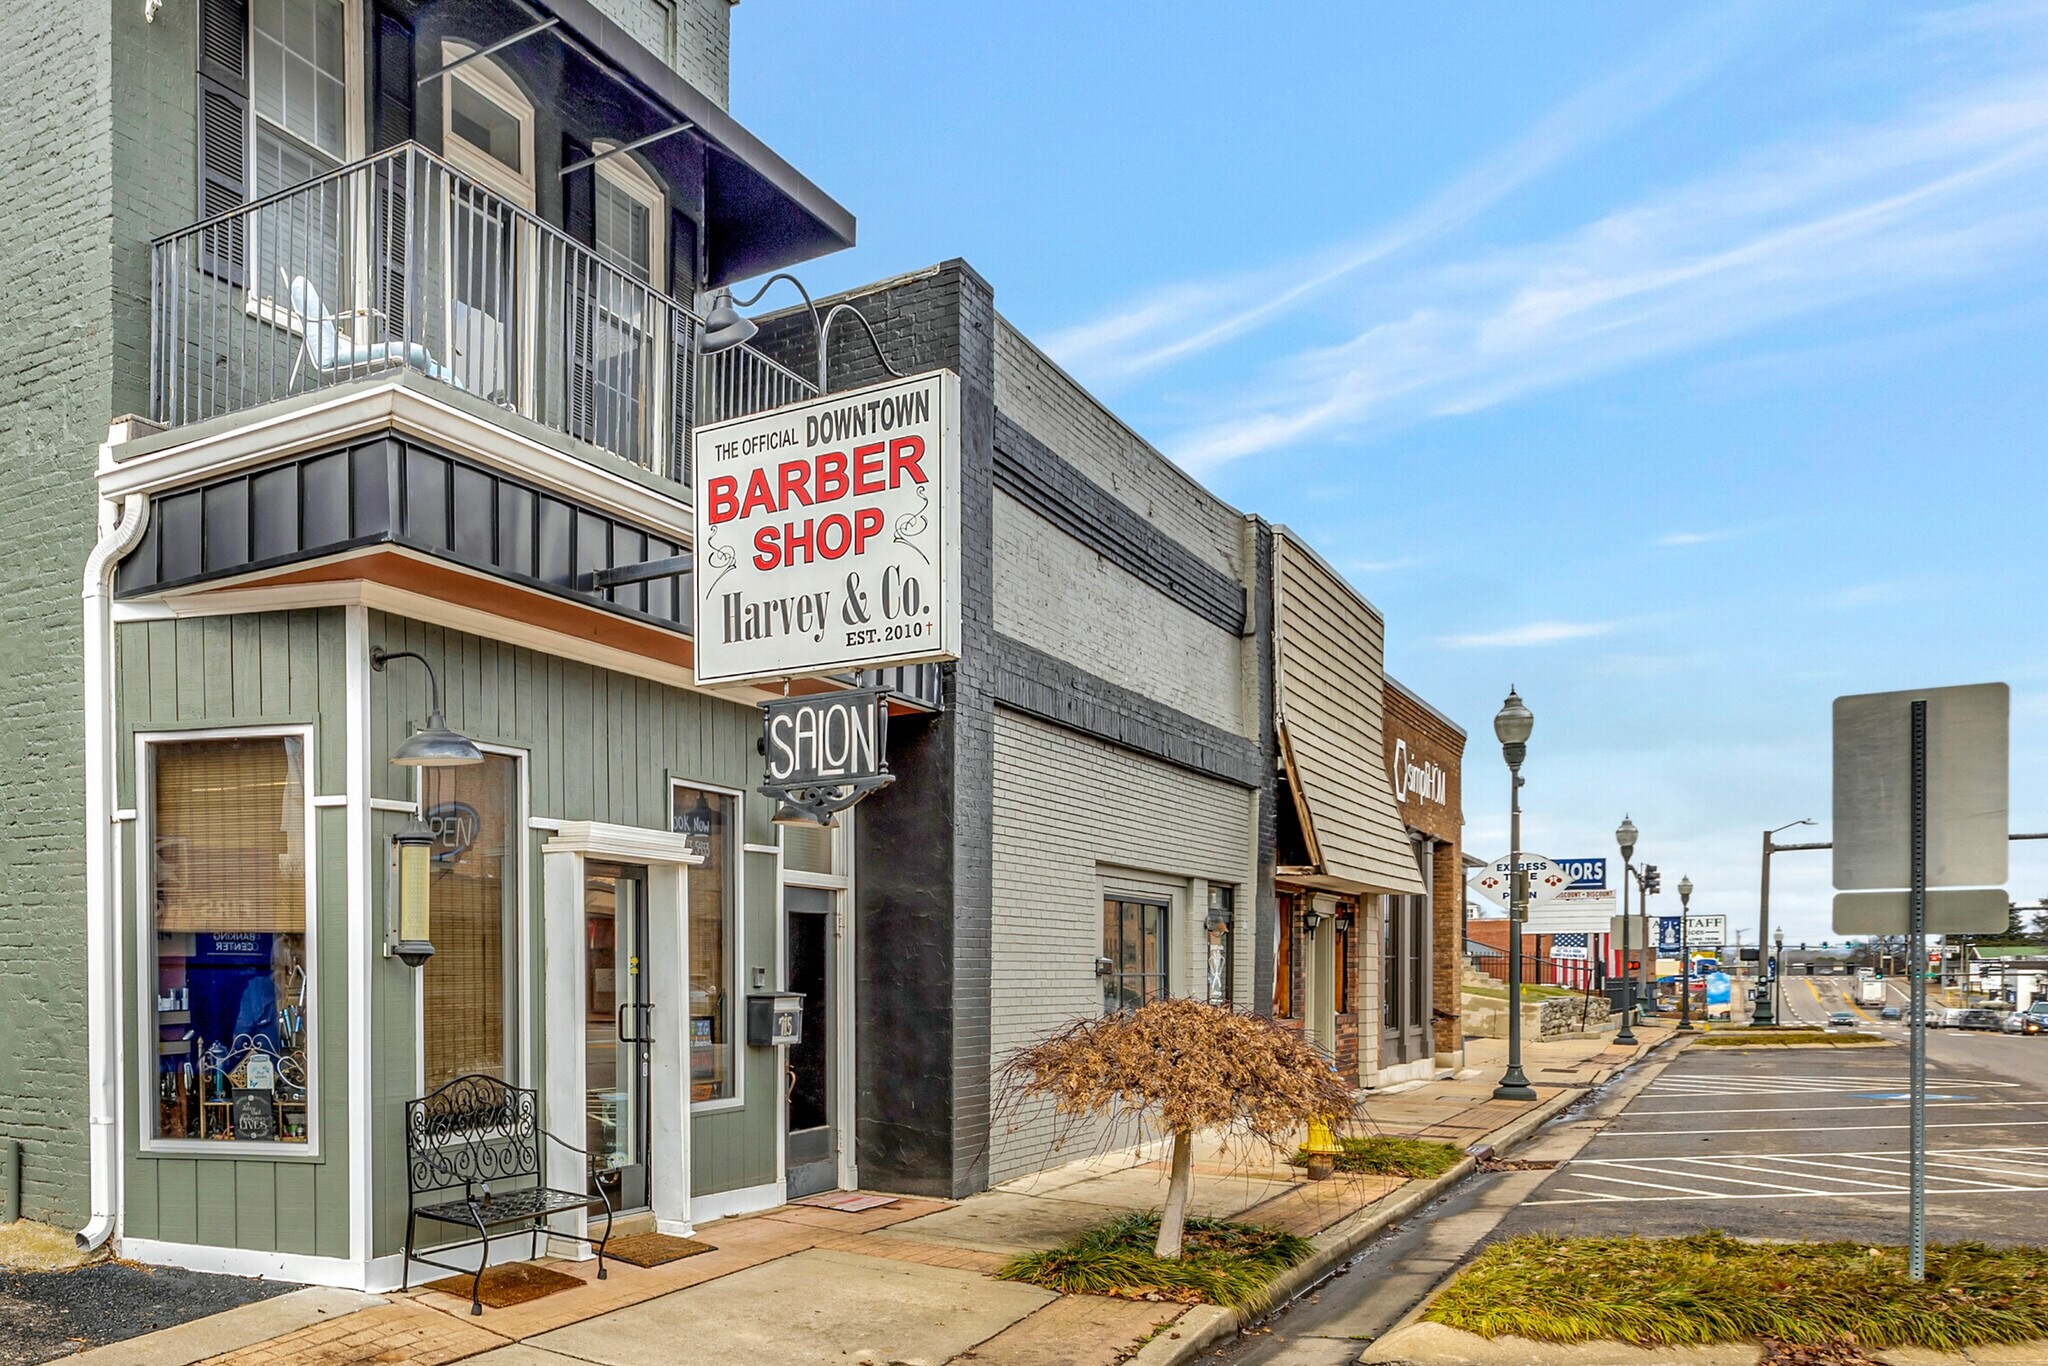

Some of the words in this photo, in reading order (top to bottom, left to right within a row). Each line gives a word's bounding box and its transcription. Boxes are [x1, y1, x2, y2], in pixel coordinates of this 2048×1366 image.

[715, 441, 738, 462] THE
[742, 428, 799, 455] OFFICIAL
[806, 389, 930, 448] DOWNTOWN
[708, 434, 930, 525] BARBER
[753, 507, 885, 571] SHOP
[722, 591, 830, 645] Harvey
[842, 571, 871, 626] &
[882, 564, 930, 620] Co.
[846, 630, 881, 647] EST.
[885, 622, 922, 642] 2010
[770, 703, 876, 780] SALON
[430, 816, 472, 847] PEN
[674, 814, 690, 831] OOK
[1496, 861, 1548, 872] EXRESS
[1502, 891, 1537, 900] PN
